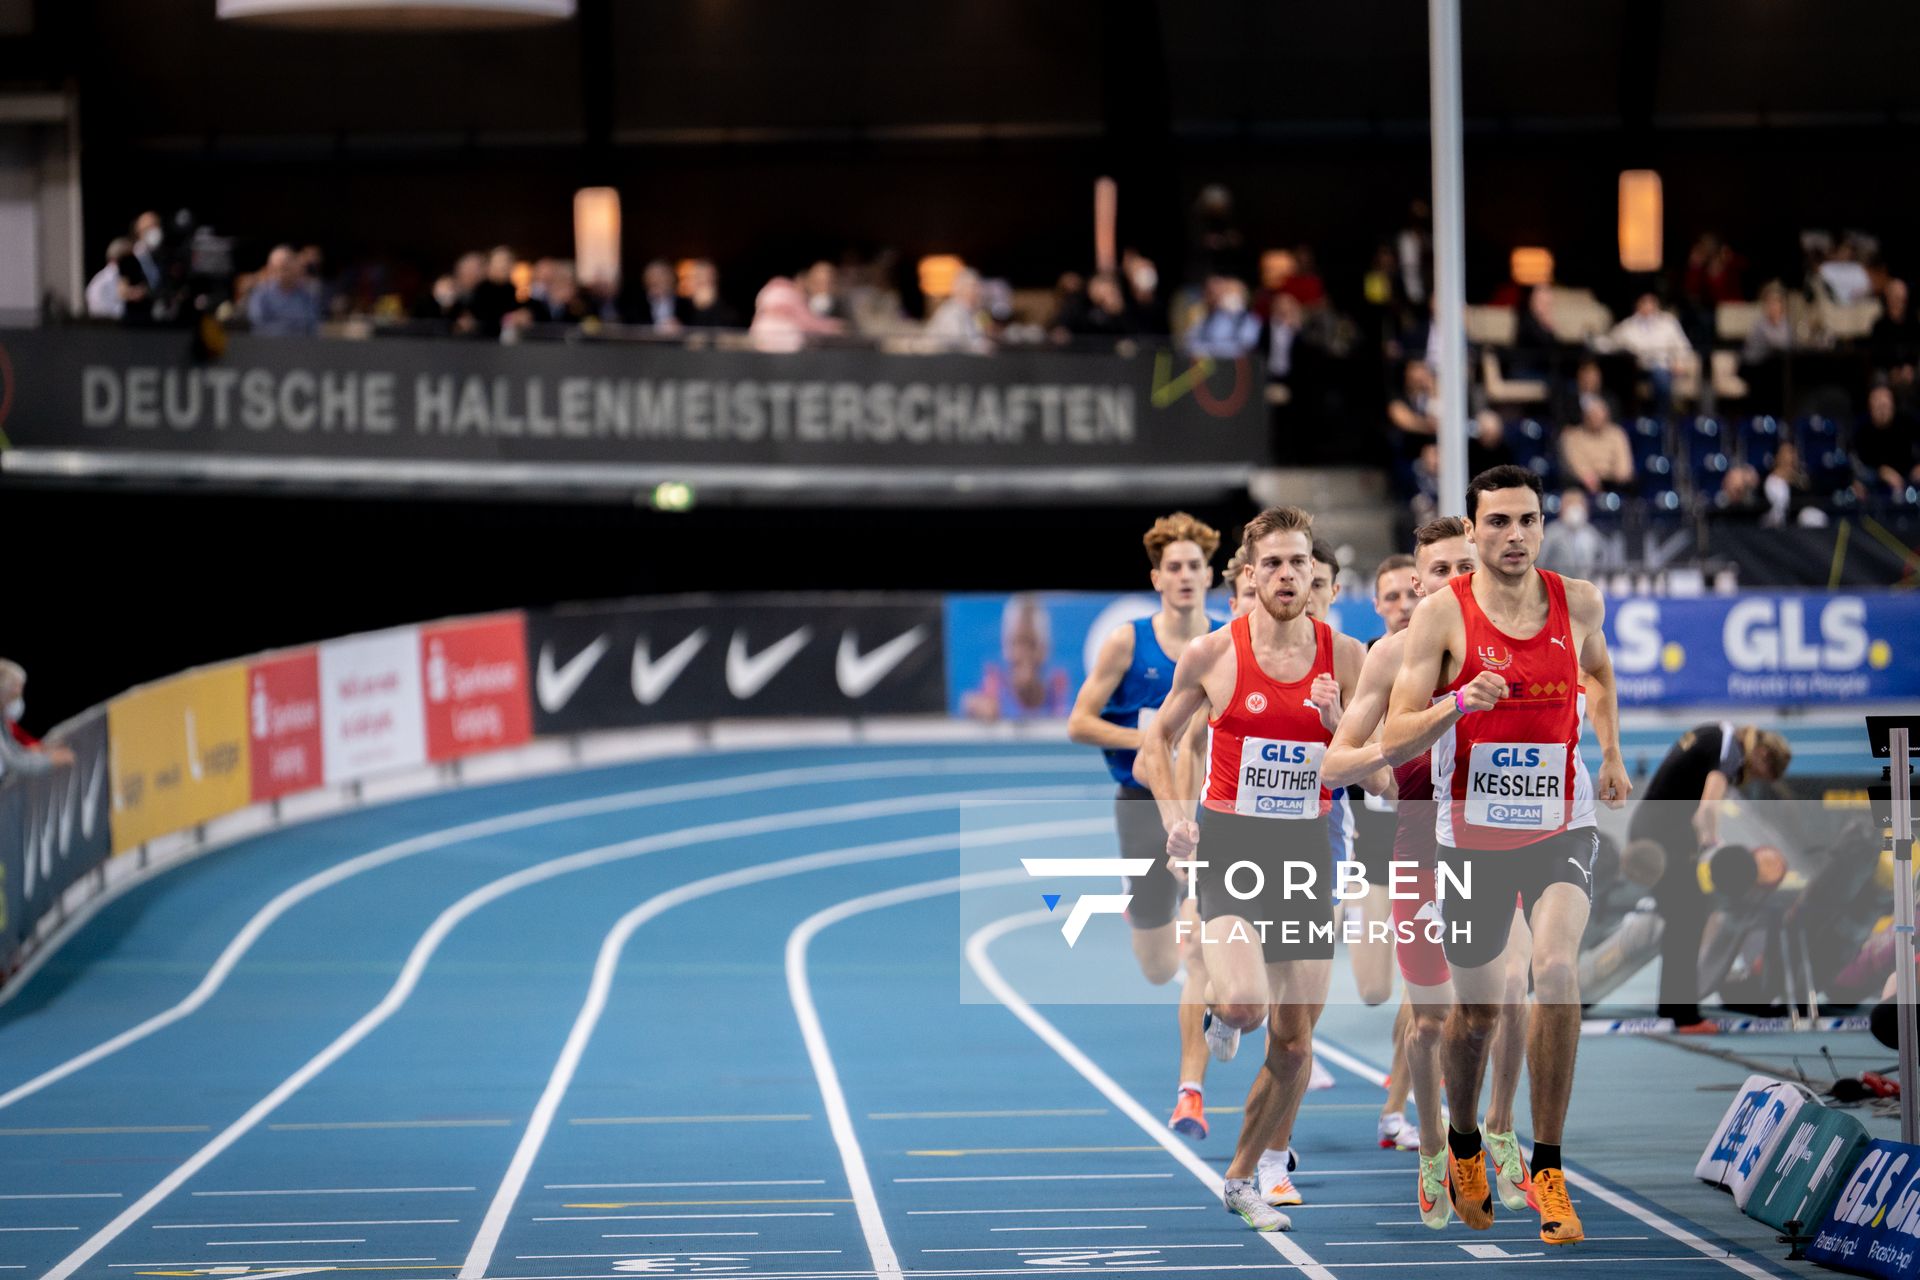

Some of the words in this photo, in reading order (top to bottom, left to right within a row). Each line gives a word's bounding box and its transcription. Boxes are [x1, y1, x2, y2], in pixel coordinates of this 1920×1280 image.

[82, 366, 398, 433] DEUTSCHE
[413, 372, 1136, 444] HALLENMEISTERSCHAFTEN
[1477, 646, 1495, 657] LG
[1261, 743, 1311, 764] GLS.
[1491, 747, 1547, 768] GLS.
[1245, 766, 1317, 791] REUTHER
[1473, 771, 1559, 797] KESSLER
[1276, 800, 1303, 810] PLAN
[1510, 808, 1541, 818] PLAN
